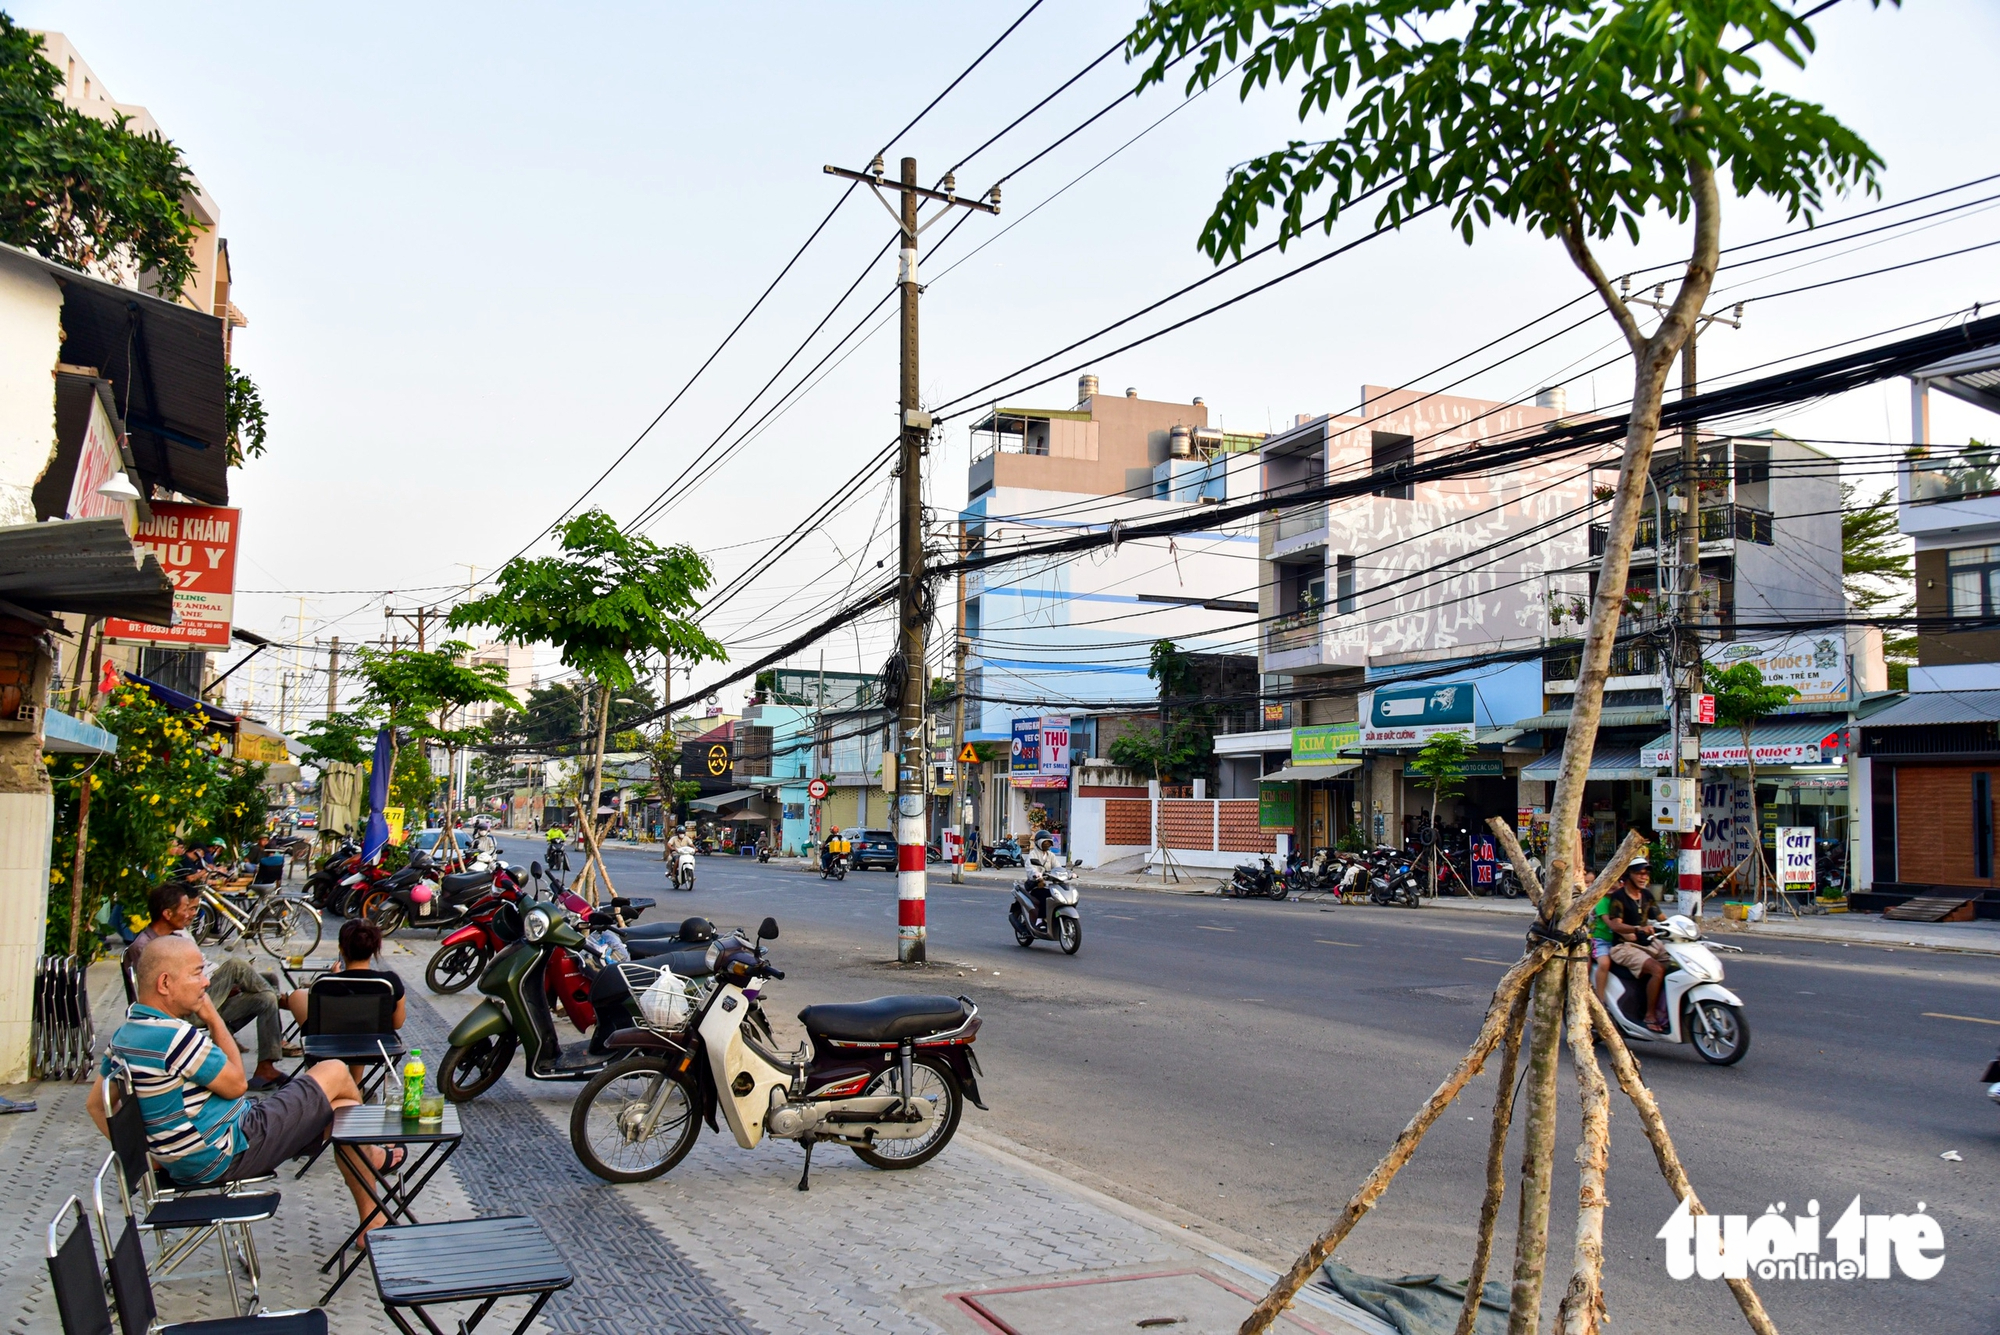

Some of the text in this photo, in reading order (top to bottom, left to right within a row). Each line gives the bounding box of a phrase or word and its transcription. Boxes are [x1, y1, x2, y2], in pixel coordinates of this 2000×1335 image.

[182, 515, 231, 543] KHÁM
[204, 547, 227, 569] Y
[174, 593, 207, 602] CLINIC
[184, 602, 223, 611] ANIMAL
[1806, 654, 1813, 668] 3
[1808, 671, 1820, 679] EM
[1044, 728, 1068, 747] THÚ
[1299, 736, 1326, 751] KIM
[1052, 747, 1060, 762] Y
[1756, 745, 1792, 759] QUỐC
[1795, 746, 1803, 757] 3
[391, 812, 401, 820] 77
[1786, 830, 1812, 849] CẮT
[1477, 865, 1492, 883] XE
